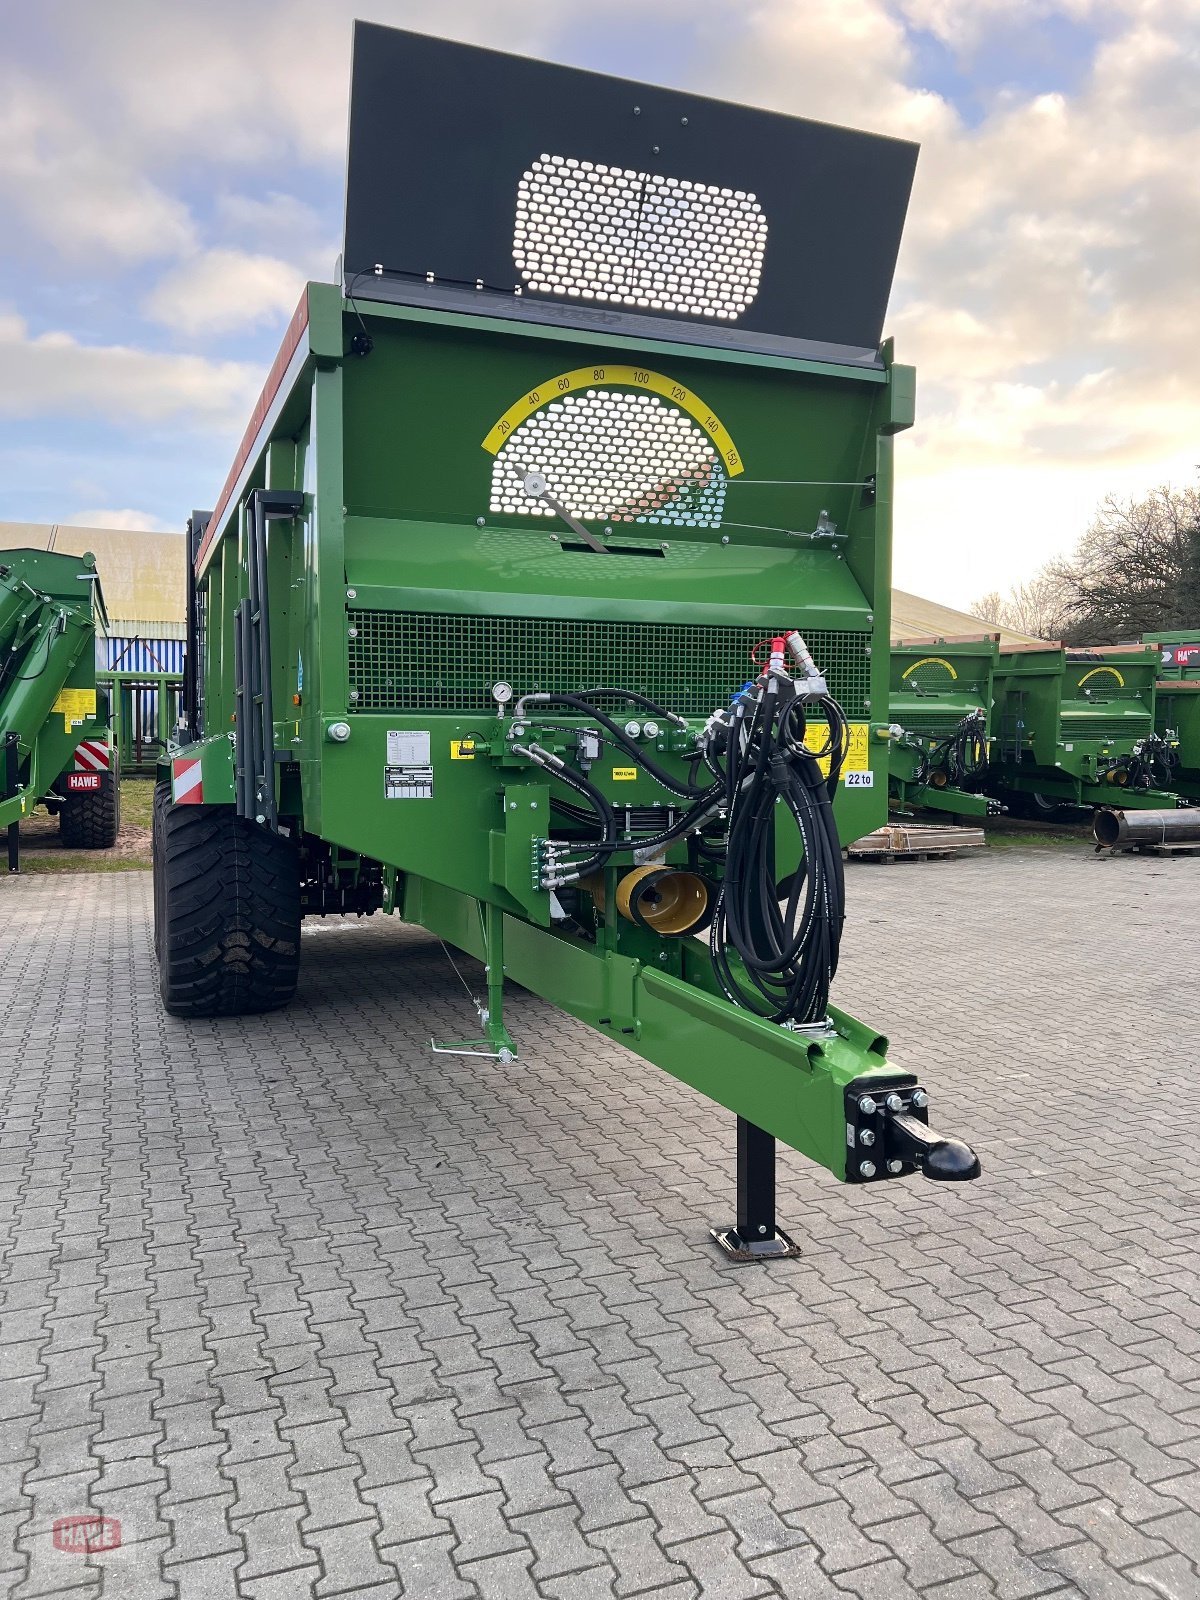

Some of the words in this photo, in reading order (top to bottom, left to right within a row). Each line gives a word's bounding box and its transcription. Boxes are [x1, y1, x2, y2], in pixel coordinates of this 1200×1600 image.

[593, 370, 605, 380] 80
[633, 372, 650, 384] 100
[558, 378, 570, 390] 60
[528, 392, 540, 406] 40
[670, 386, 686, 402] 120
[498, 420, 510, 434] 20
[704, 416, 718, 432] 140
[726, 449, 738, 466] 150
[70, 776, 98, 787] HAWE
[848, 774, 860, 784] 22
[862, 774, 871, 784] to
